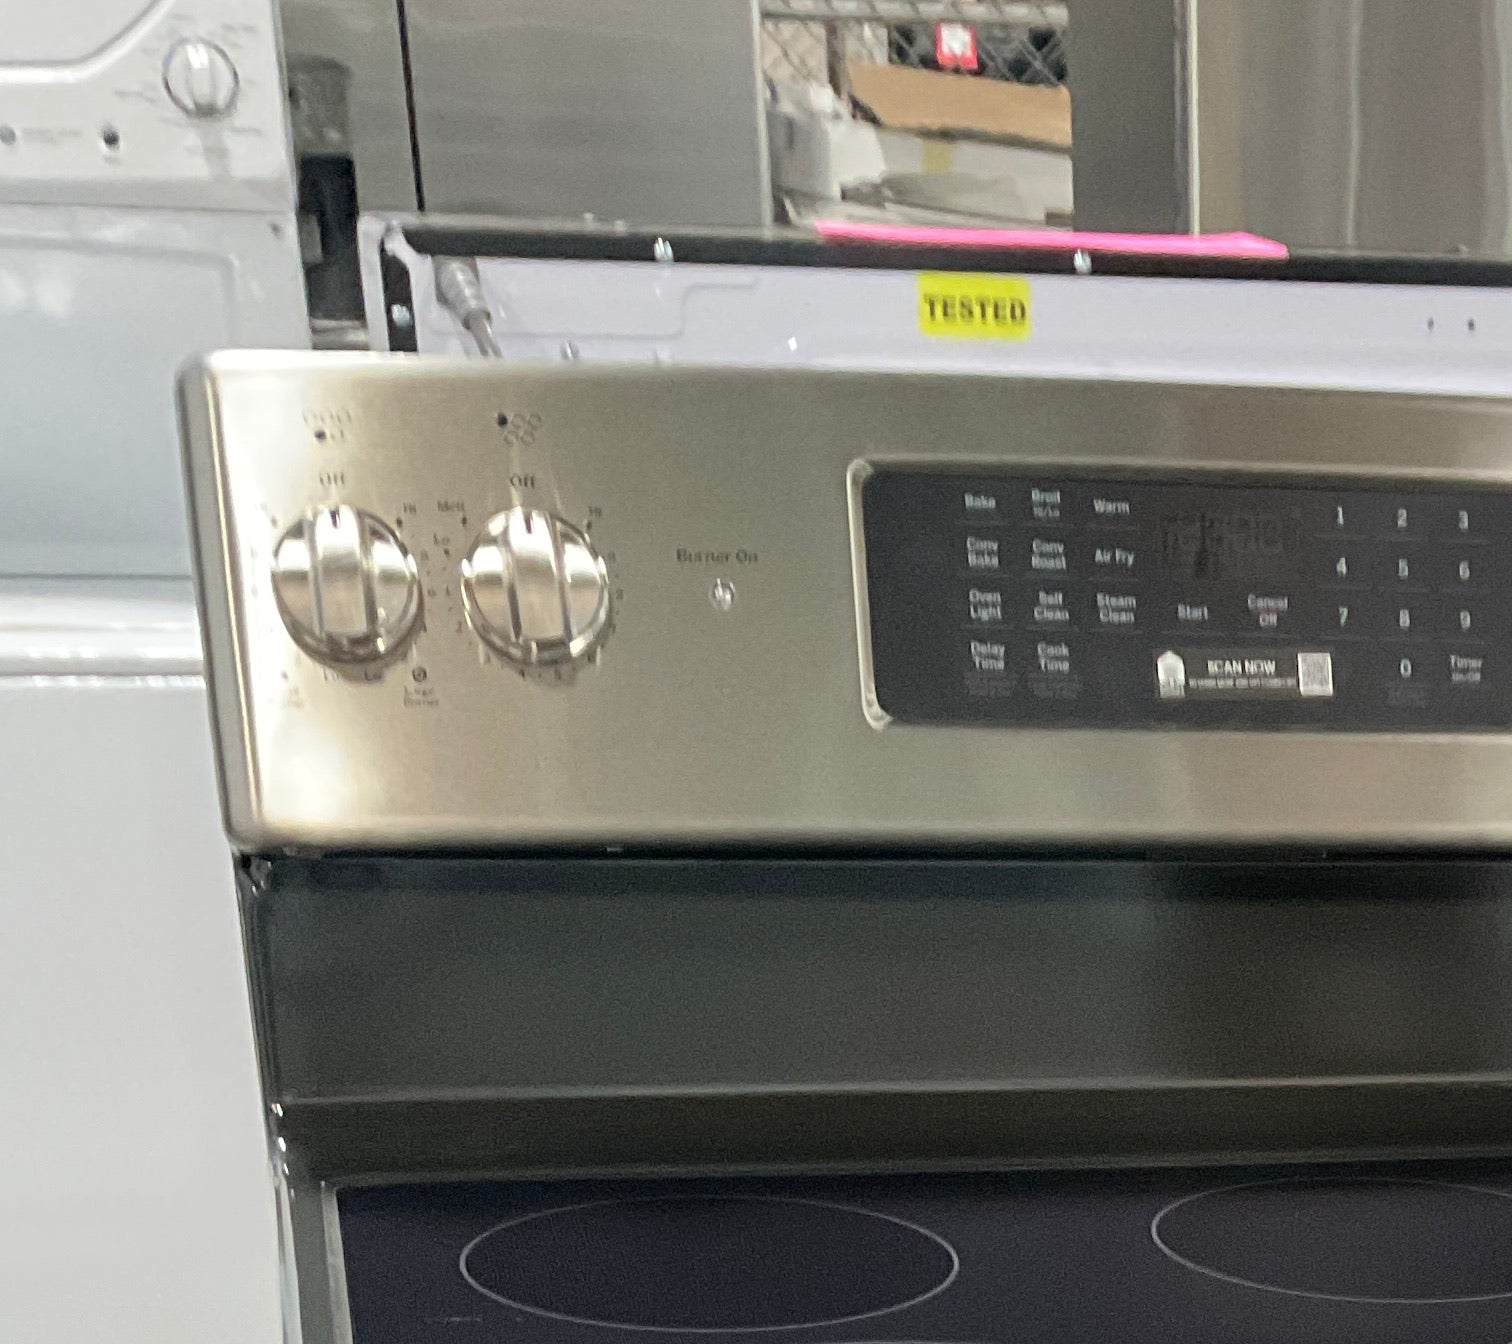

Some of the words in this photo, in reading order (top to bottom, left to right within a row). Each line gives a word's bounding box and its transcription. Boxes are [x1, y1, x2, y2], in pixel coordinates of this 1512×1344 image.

[923, 292, 1028, 326] TESTED
[509, 473, 535, 489] Off
[964, 492, 996, 509] Bake
[1094, 499, 1130, 514] Warm
[1337, 506, 1345, 525] 1
[676, 547, 729, 563] Burner
[735, 549, 758, 563] On
[1095, 549, 1113, 564] Air
[1115, 549, 1135, 567] Fry
[1336, 557, 1347, 577] 4
[1034, 605, 1069, 621] Clean
[1178, 603, 1208, 620] Start
[1339, 606, 1348, 627] 7
[1207, 659, 1242, 676] SCAN
[1244, 659, 1276, 676] NOW
